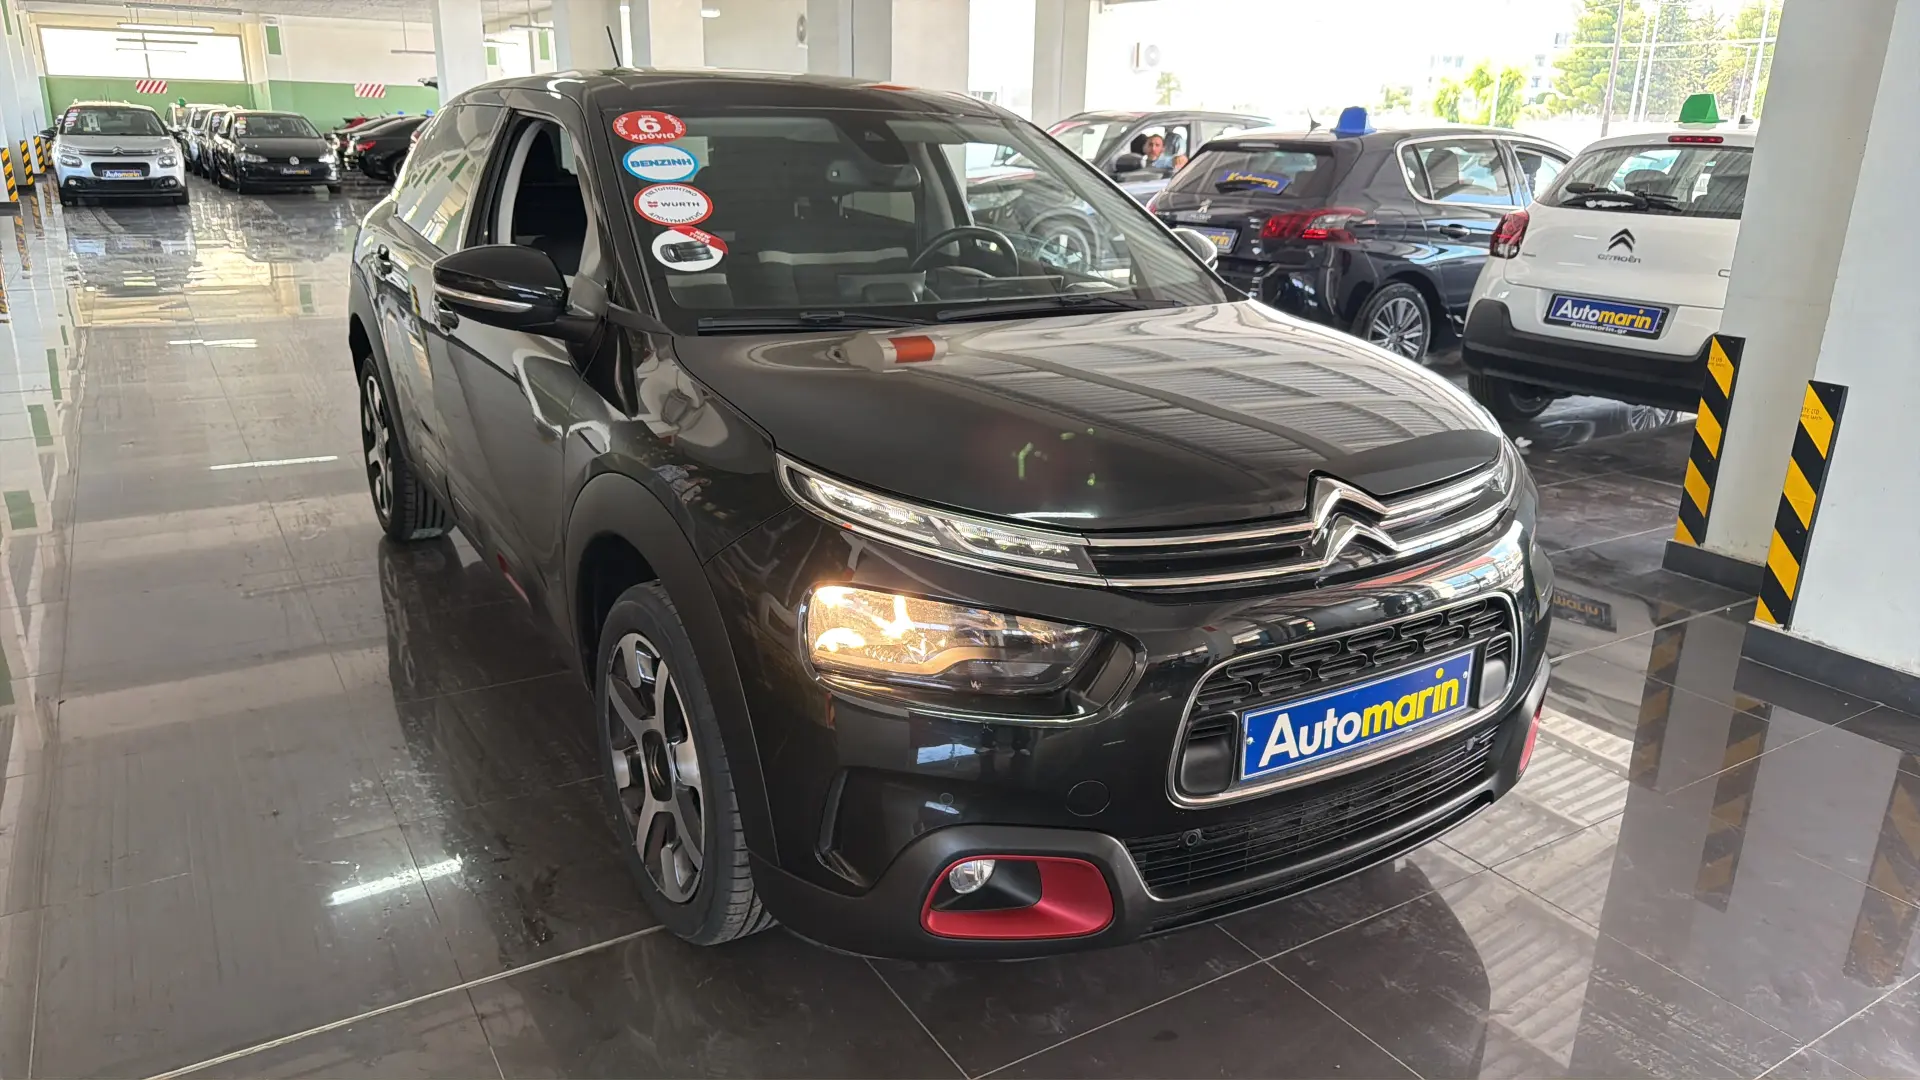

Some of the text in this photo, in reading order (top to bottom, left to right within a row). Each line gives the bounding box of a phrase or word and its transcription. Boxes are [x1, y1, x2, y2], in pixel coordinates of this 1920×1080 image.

[638, 117, 661, 133] 6
[631, 132, 675, 141] χρόνια
[106, 170, 139, 178] Automarin
[1556, 299, 1652, 330] Automarin
[1570, 321, 1628, 335] Automarin.gr
[1258, 668, 1459, 767] Automarin
